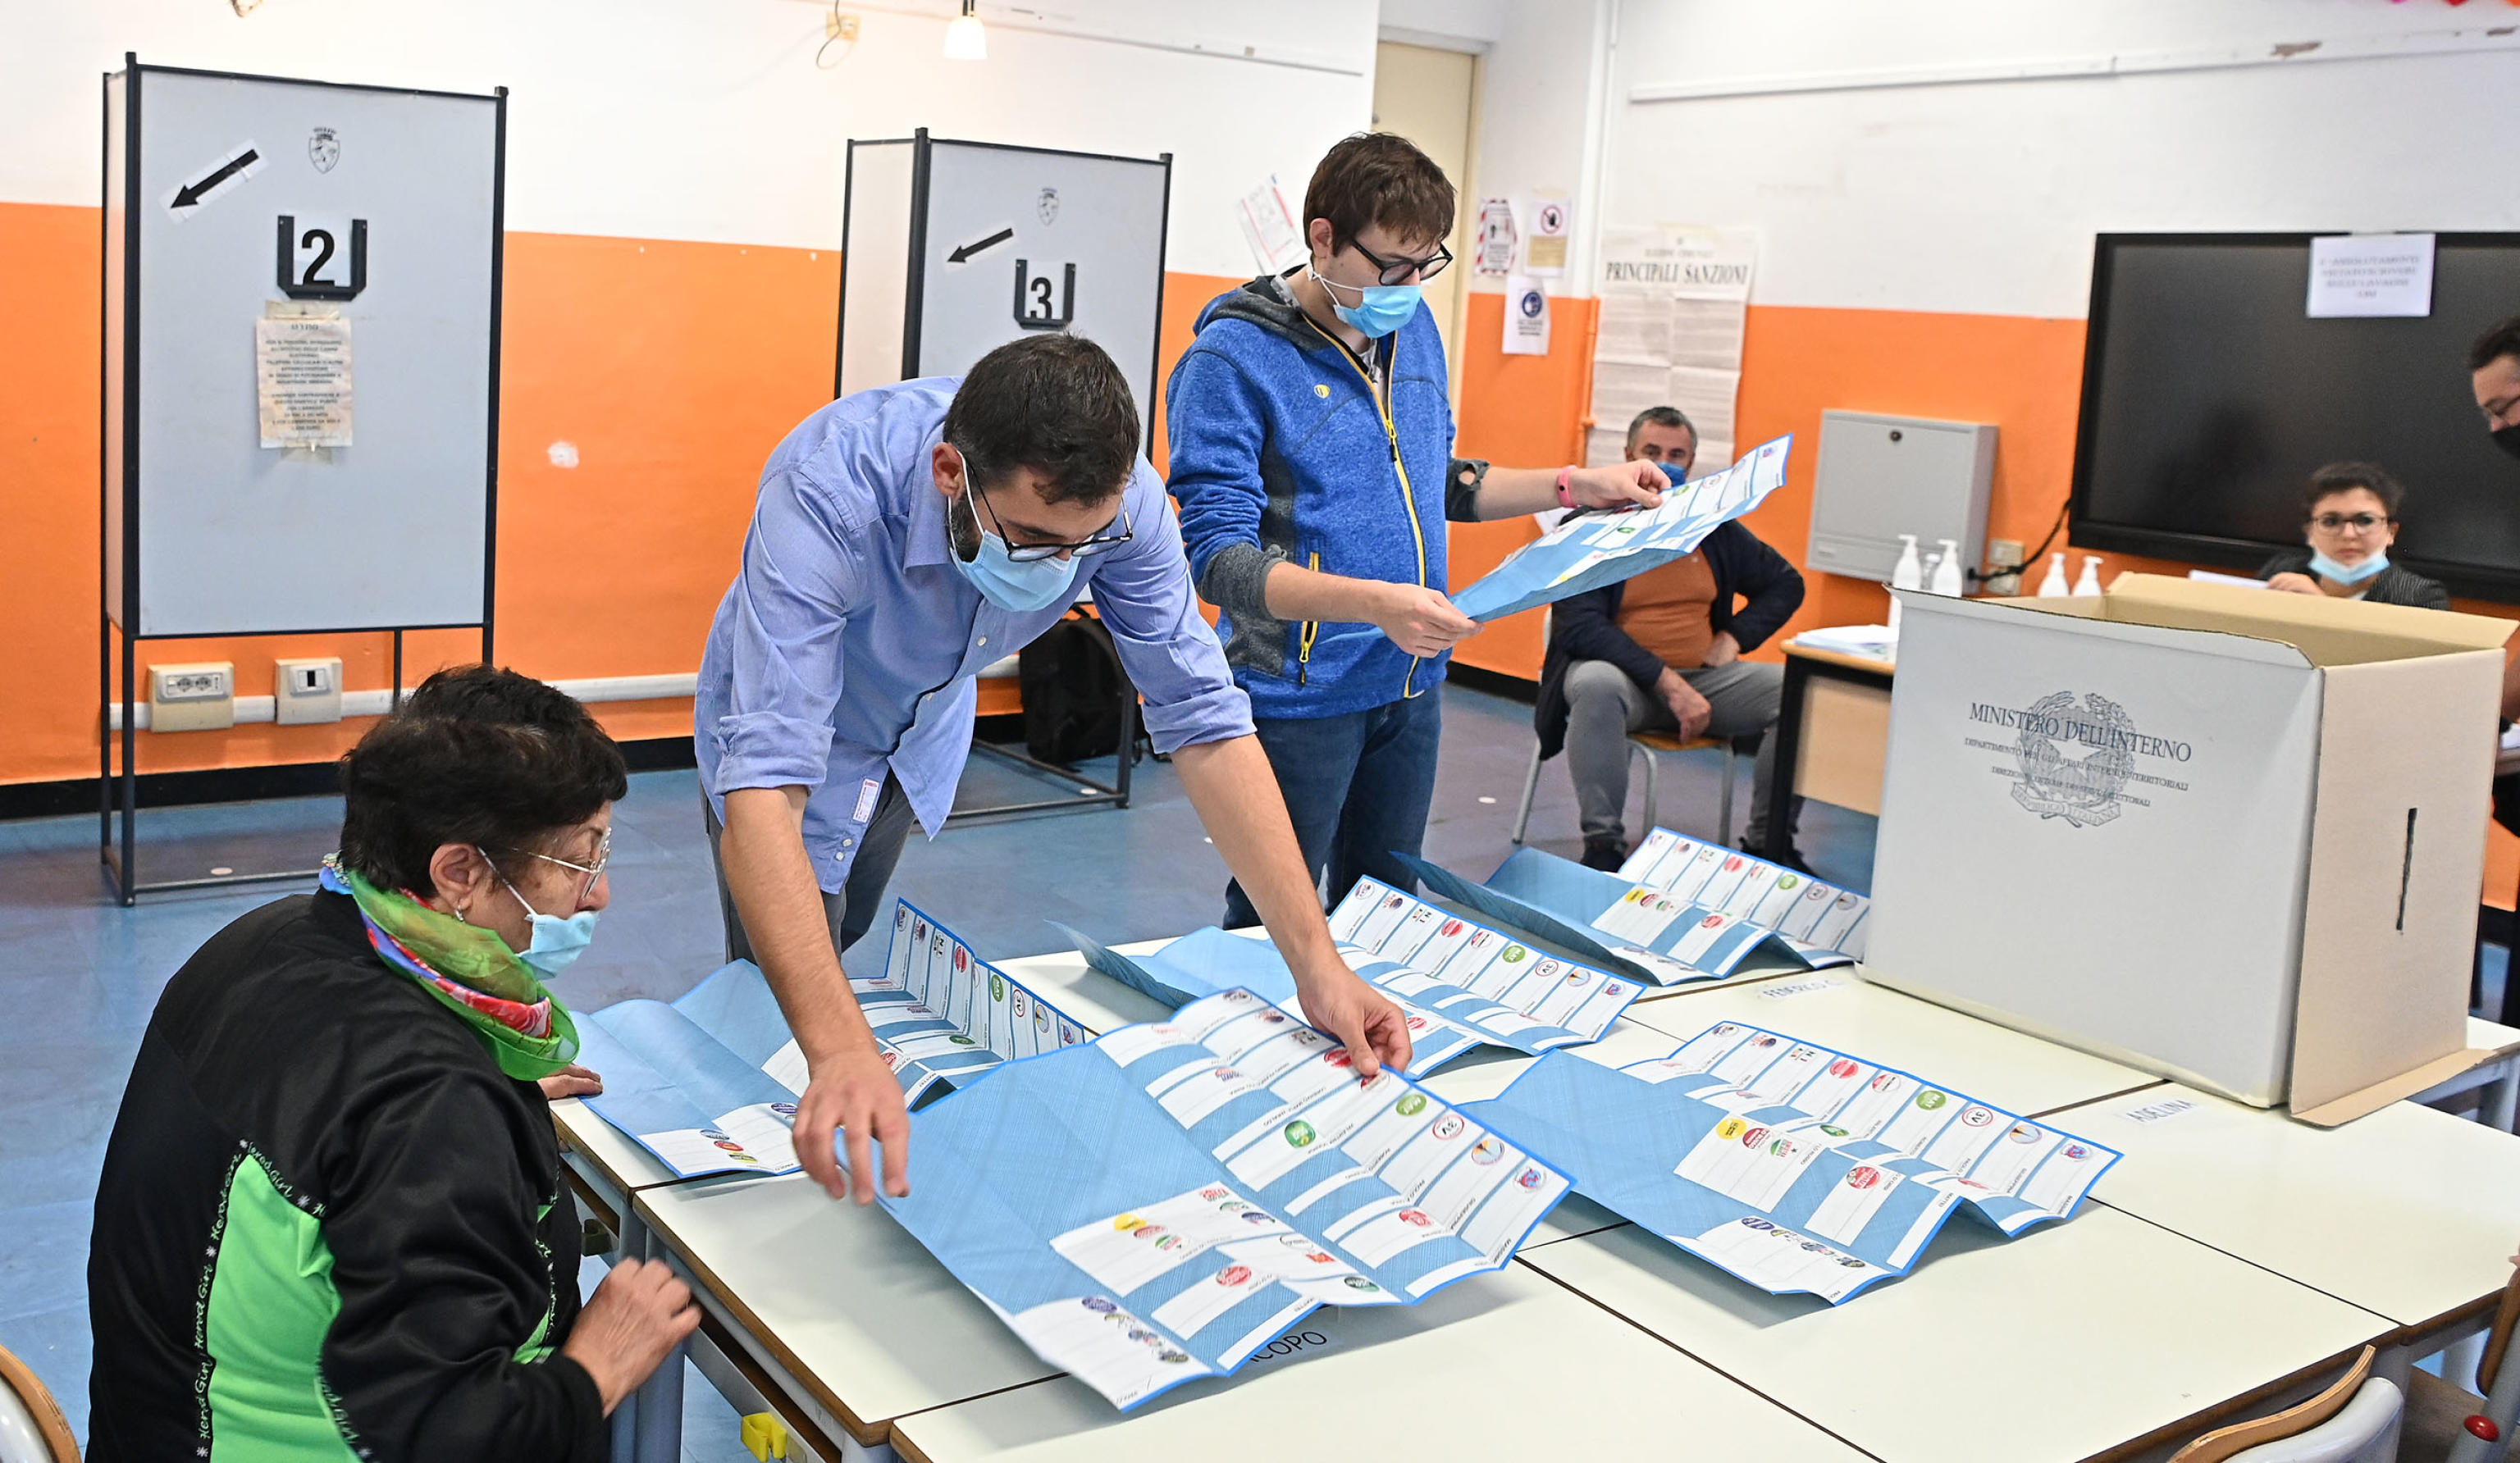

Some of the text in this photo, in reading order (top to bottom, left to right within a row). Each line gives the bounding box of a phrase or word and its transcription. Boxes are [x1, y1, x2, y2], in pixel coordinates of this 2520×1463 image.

[301, 229, 336, 286] 2
[1605, 262, 1748, 285] PRINCIPALI SANZIONI
[1030, 277, 1052, 319] 3
[1969, 701, 2193, 763] MINISTERO DELL'INTERNO
[993, 979, 1002, 998] MAT
[1014, 996, 1023, 1011] 3V
[1923, 1091, 1940, 1110] MAT
[2125, 1099, 2197, 1122] ADELINA
[1970, 1108, 1985, 1125] 3V
